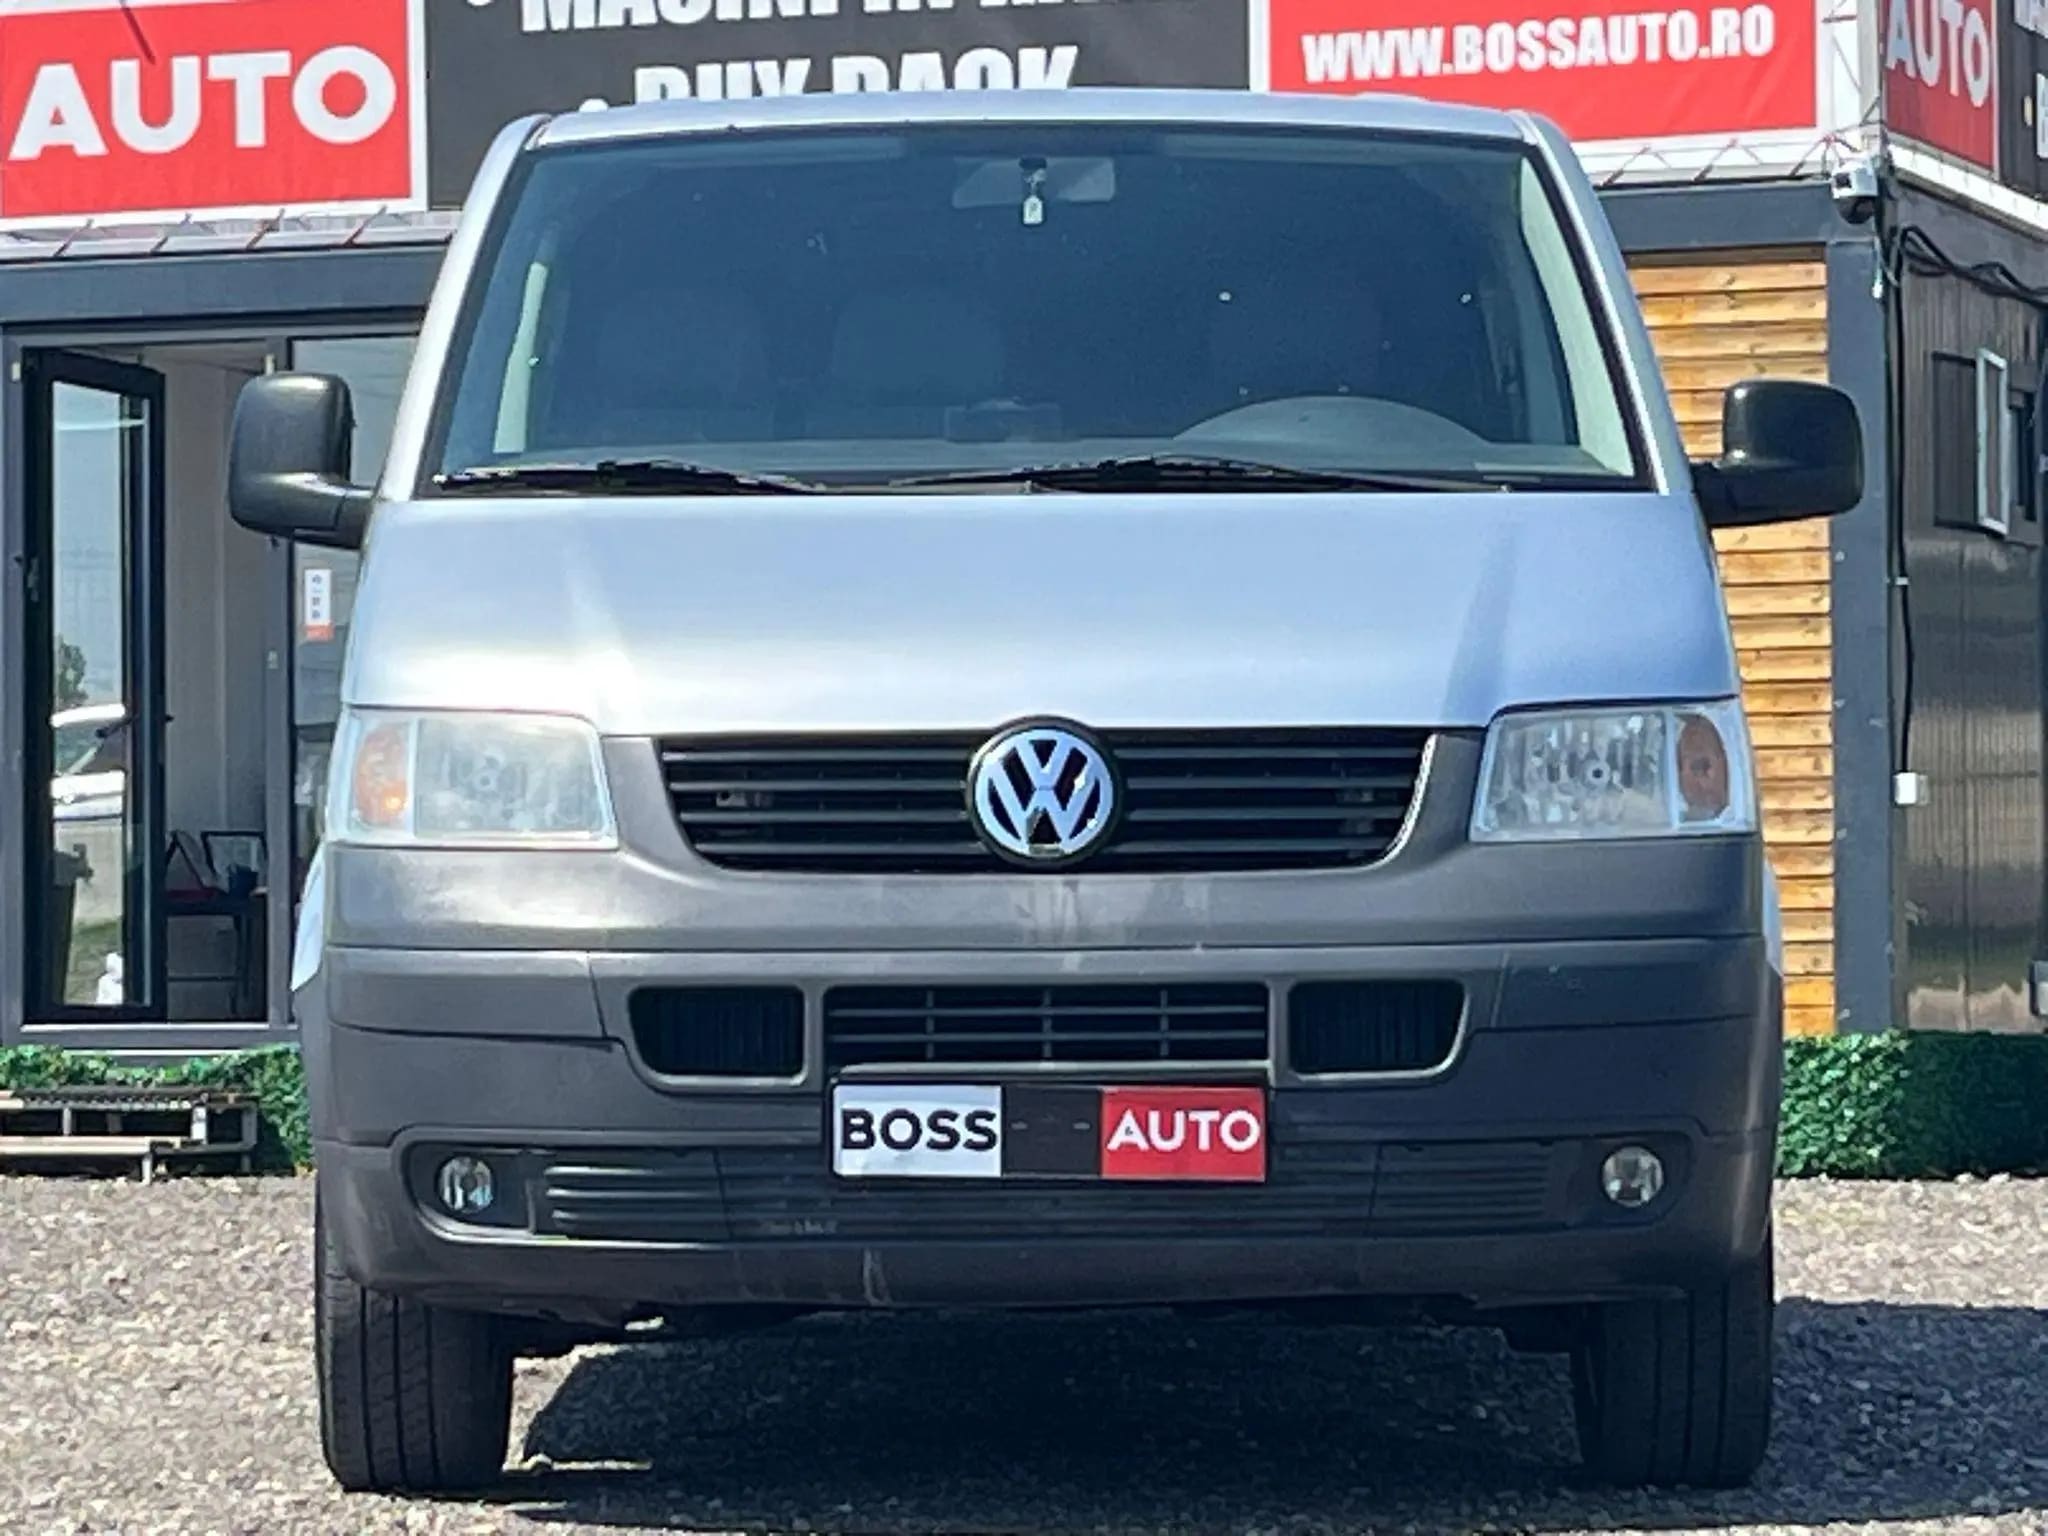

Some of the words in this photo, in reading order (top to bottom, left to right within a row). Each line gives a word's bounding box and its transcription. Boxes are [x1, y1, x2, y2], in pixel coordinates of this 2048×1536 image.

[1301, 4, 1775, 83] WWW.BOSSAUTO.RO
[1885, 0, 1990, 108] AUTO
[9, 45, 396, 160] AUTO
[840, 1108, 998, 1151] BOSS
[1106, 1109, 1261, 1152] AUTO
